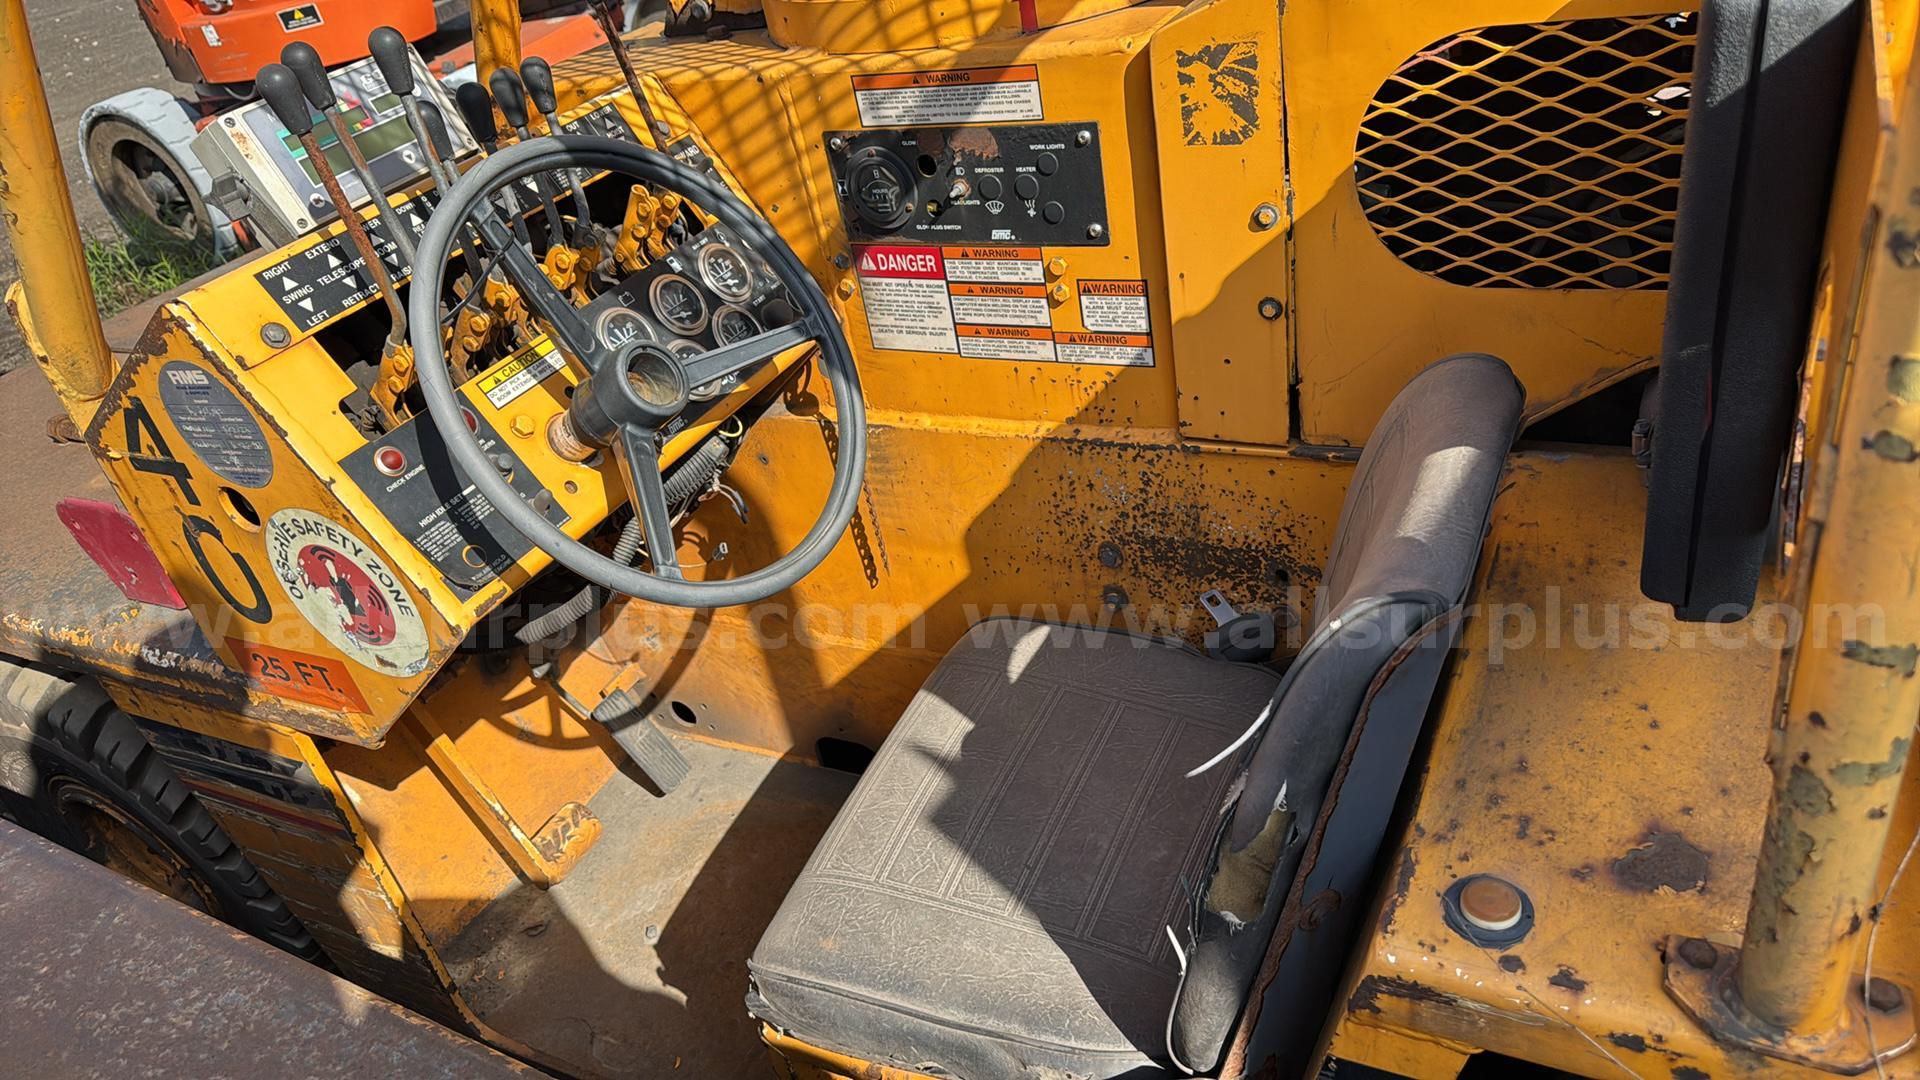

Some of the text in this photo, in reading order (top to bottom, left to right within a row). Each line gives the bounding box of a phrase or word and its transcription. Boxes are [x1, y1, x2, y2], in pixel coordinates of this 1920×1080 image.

[926, 73, 970, 83] WARNING
[566, 121, 579, 131] OUT
[395, 203, 415, 215] DOWN
[305, 238, 340, 260] EXTEND
[973, 249, 1018, 257] WARNING
[262, 262, 292, 280] RIGHT
[317, 256, 367, 286] TELESCOPE
[877, 253, 937, 272] DANGER
[282, 284, 314, 304] SWING
[980, 286, 1024, 294] WARNING
[1091, 284, 1144, 293] WARNING
[306, 310, 330, 327] LEFT
[987, 328, 1030, 336] WARNING
[1078, 335, 1127, 344] WARNING
[502, 350, 539, 377] CAUTION
[498, 384, 508, 392] NOT
[509, 377, 519, 385] PICK
[497, 390, 511, 401] BOOM
[386, 464, 425, 492] CHECK ENGINE
[418, 493, 463, 527] HIGH IDLE SET
[291, 518, 363, 557] SAFETY
[366, 559, 414, 618] ZONE
[252, 653, 343, 693] 25 FT.
